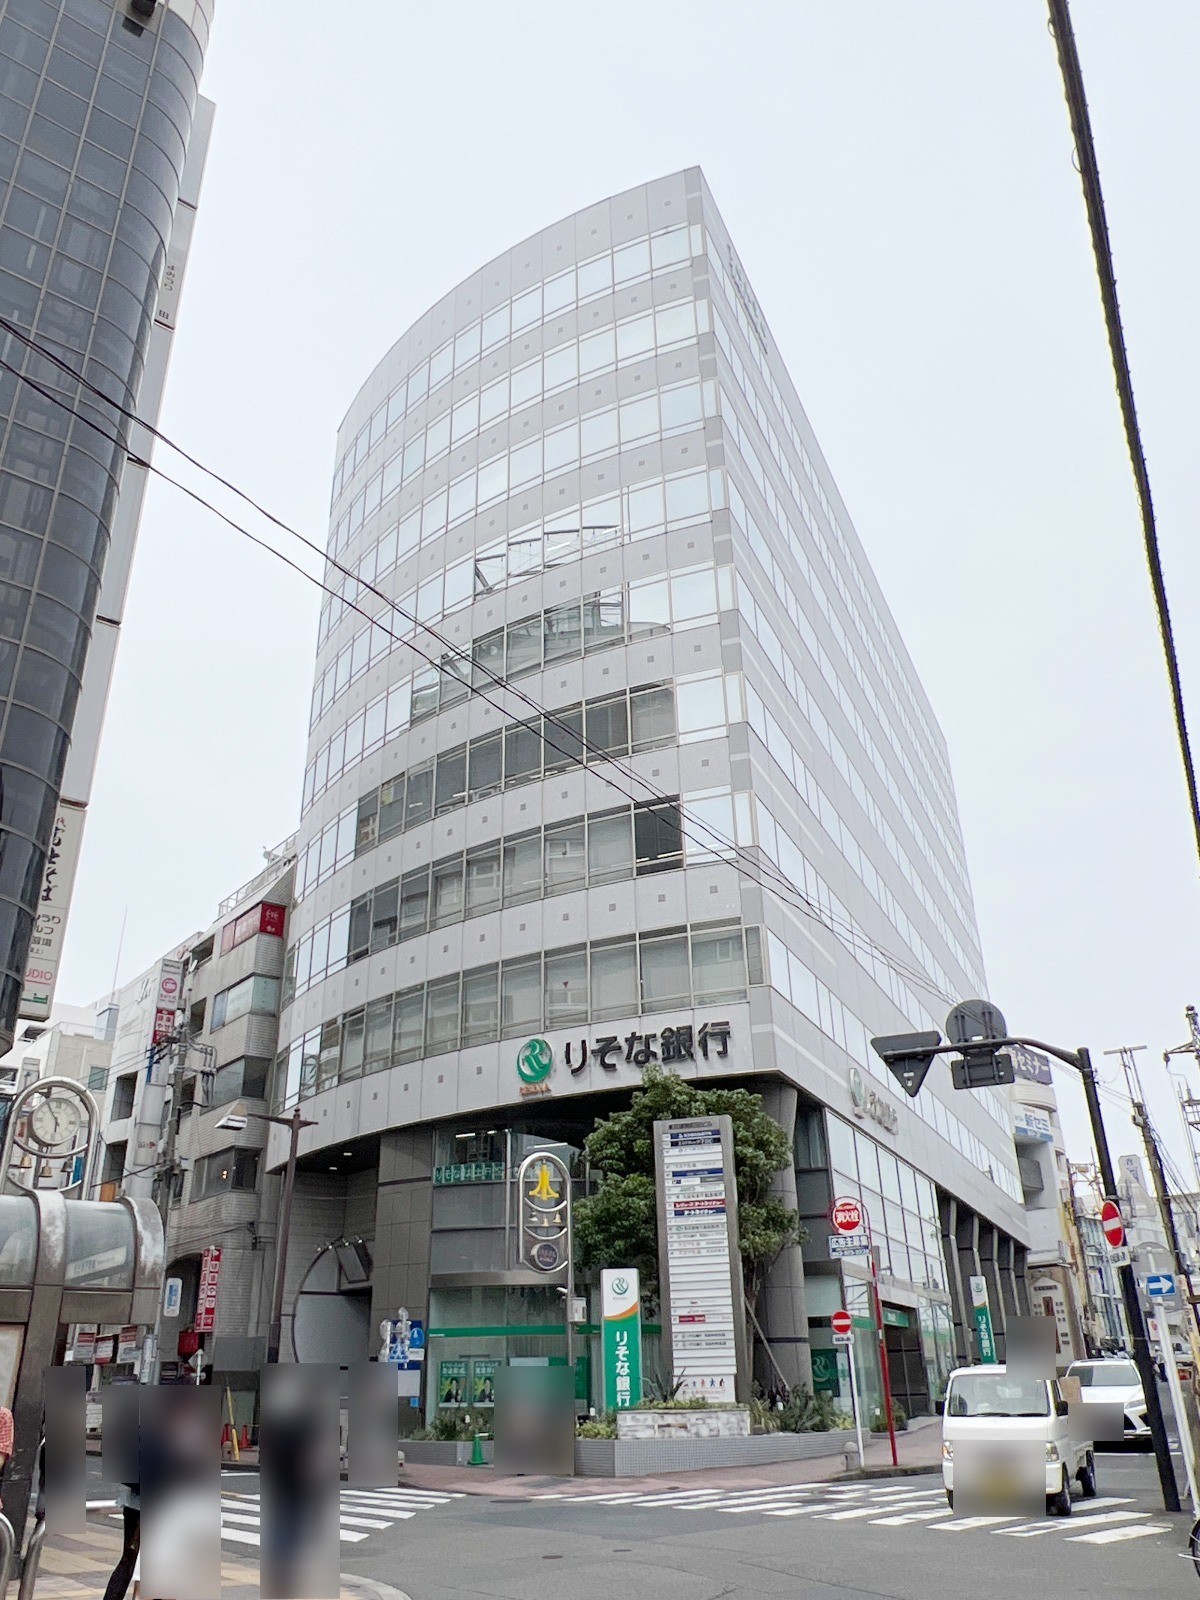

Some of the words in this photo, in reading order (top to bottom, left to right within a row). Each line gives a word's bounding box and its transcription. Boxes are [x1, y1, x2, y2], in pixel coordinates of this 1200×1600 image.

[565, 1021, 732, 1076] りそな銀行
[835, 1210, 860, 1223] 消火栓
[976, 1315, 991, 1357] りそな銀行
[615, 1330, 631, 1407] りそな銀行
